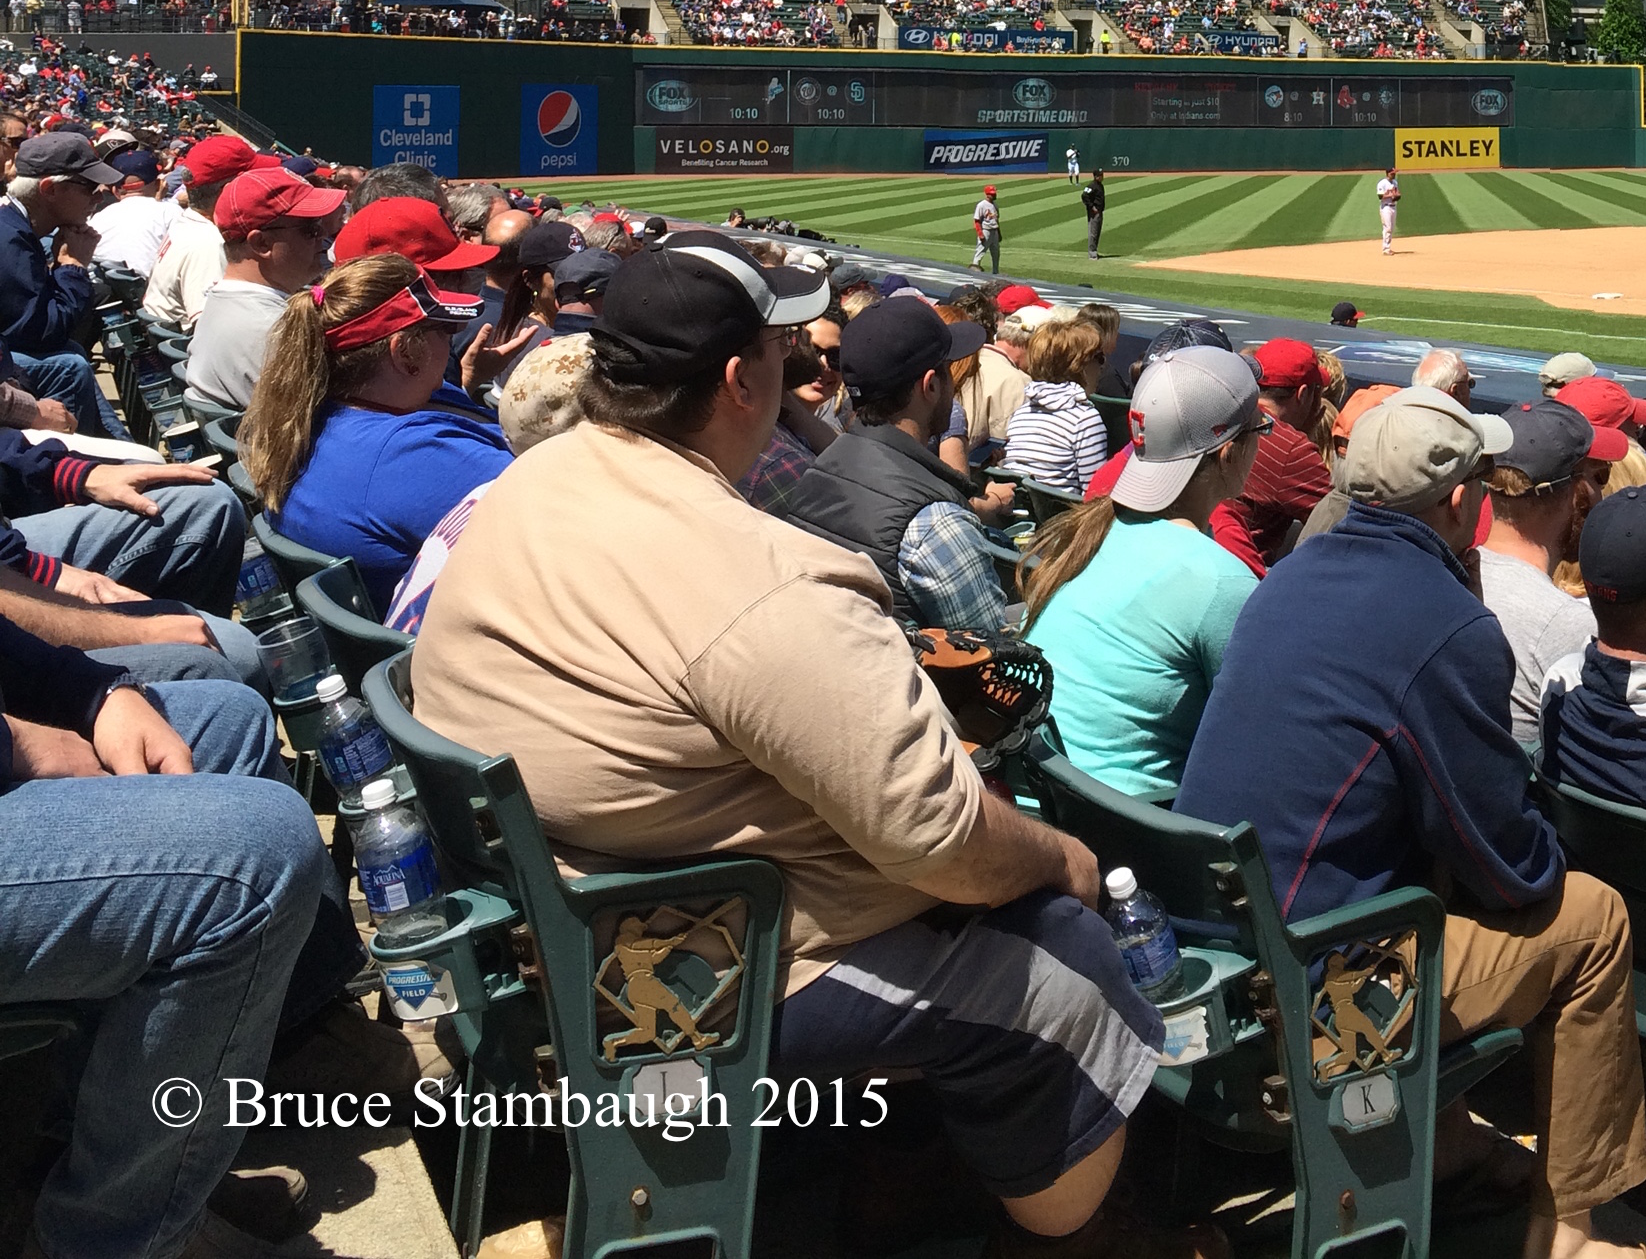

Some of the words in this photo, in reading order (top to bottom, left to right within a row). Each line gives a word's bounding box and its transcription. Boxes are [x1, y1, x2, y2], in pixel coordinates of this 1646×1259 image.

[1225, 35, 1276, 47] HYUNDAI
[817, 108, 845, 120] 10:10
[379, 129, 453, 147] Cleveland
[660, 139, 790, 156] VELOSANO.org
[929, 138, 1046, 164] PROGRESSIVE
[1402, 139, 1494, 159] STANLEY
[394, 150, 437, 169] Clinic
[541, 152, 577, 169] pepsi
[681, 158, 715, 168] Benefiting
[715, 159, 738, 167] Cancer
[739, 158, 769, 167] Research
[1112, 155, 1130, 167] 370
[402, 988, 426, 998] FIELD
[1361, 1084, 1376, 1115] K
